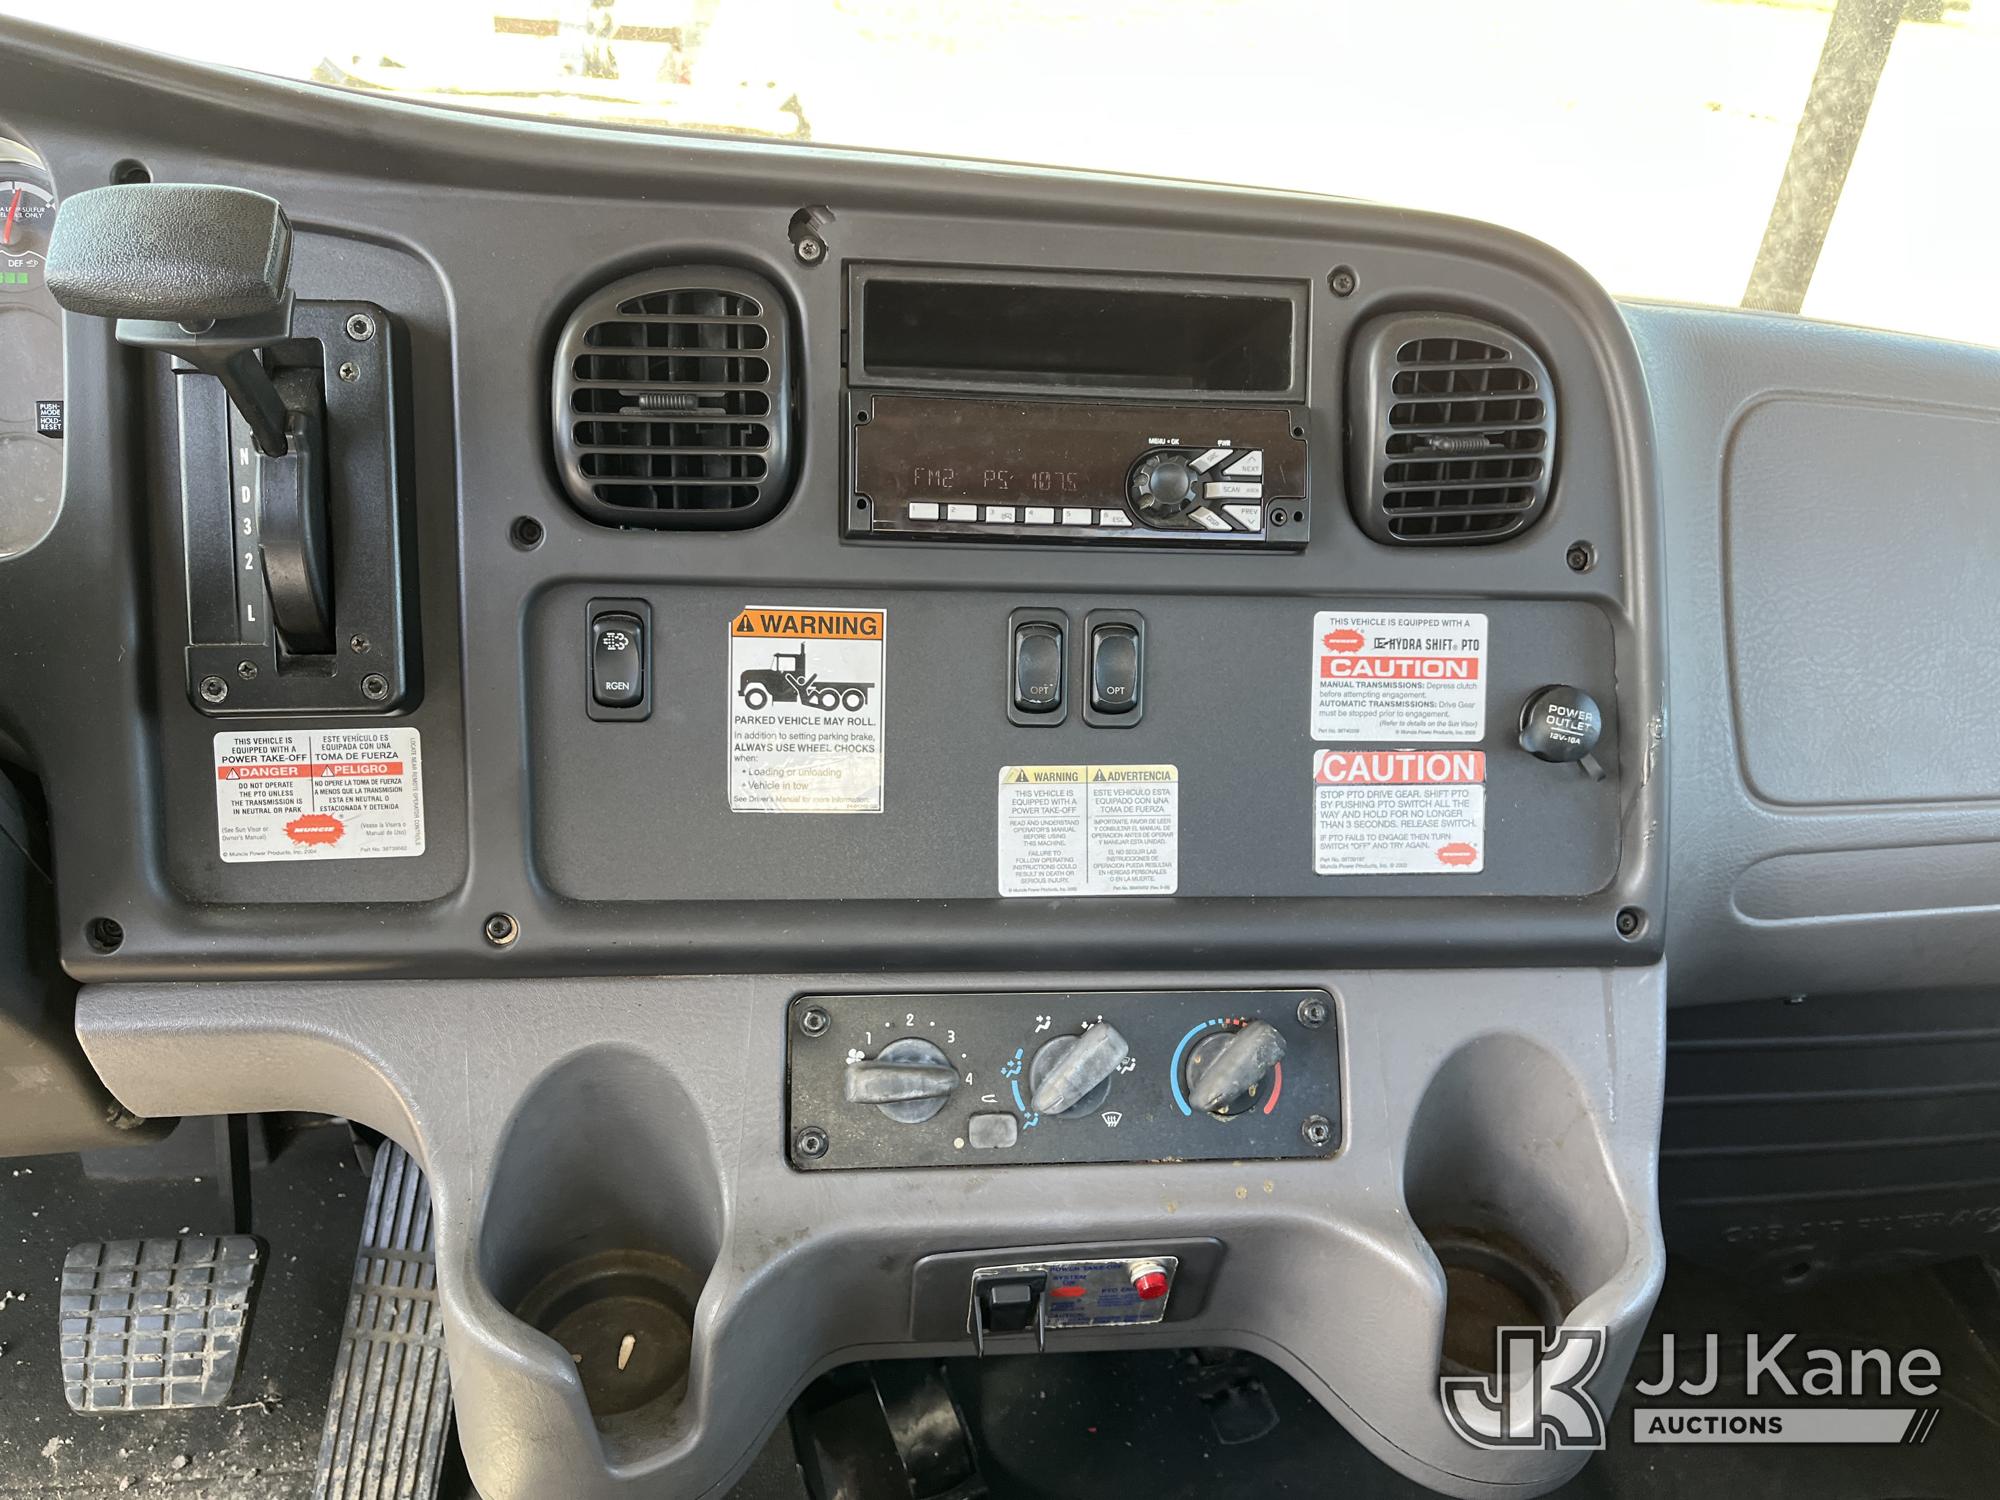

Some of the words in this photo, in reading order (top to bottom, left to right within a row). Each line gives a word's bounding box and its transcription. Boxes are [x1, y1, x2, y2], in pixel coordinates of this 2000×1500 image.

[240, 448, 248, 465] N
[914, 468, 954, 487] FM2
[242, 486, 250, 503] D
[244, 518, 252, 535] 3
[245, 553, 253, 570] 2
[248, 605, 255, 622] L
[760, 614, 877, 635] WARNING
[1390, 638, 1422, 650] HYDRA
[1462, 639, 1480, 651] PTO
[1330, 659, 1468, 677] CAUTION
[606, 682, 629, 690] RGEN
[1030, 686, 1049, 695] OPT
[1107, 686, 1125, 695] OPT
[1548, 704, 1592, 721] POWER
[734, 716, 775, 724] PARKED
[778, 716, 820, 725] VEHICLE
[824, 717, 844, 726] MAY
[848, 717, 876, 726] ROLL.
[1546, 715, 1592, 730] OUTLET
[789, 732, 816, 742] setting
[818, 733, 848, 742] parking
[851, 734, 875, 742] brake,
[734, 743, 773, 751] ALWAYS
[776, 744, 796, 752] USE
[797, 744, 832, 752] WHEEL
[834, 745, 875, 753] CHOCKS
[261, 754, 307, 762] TAKE-OFF
[240, 767, 298, 776] DANGER
[334, 764, 388, 774] PELIGRO
[748, 768, 784, 778] Loading
[798, 768, 841, 778] unloading
[1324, 754, 1474, 782] CAUTION
[1034, 772, 1078, 781] WARNING
[1108, 771, 1171, 781] ADVERTENCIA
[748, 782, 781, 790] Vehicle
[783, 782, 790, 790] in
[793, 782, 808, 790] tow
[1320, 791, 1344, 799] STOP
[1451, 789, 1469, 797] PTO
[1390, 810, 1408, 818] FOR
[1427, 810, 1462, 818] LONGER
[1320, 820, 1344, 828] THAN
[906, 1013, 914, 1026] 2
[866, 1032, 871, 1045] 1
[947, 1030, 955, 1043] 3
[965, 1072, 973, 1085] 4
